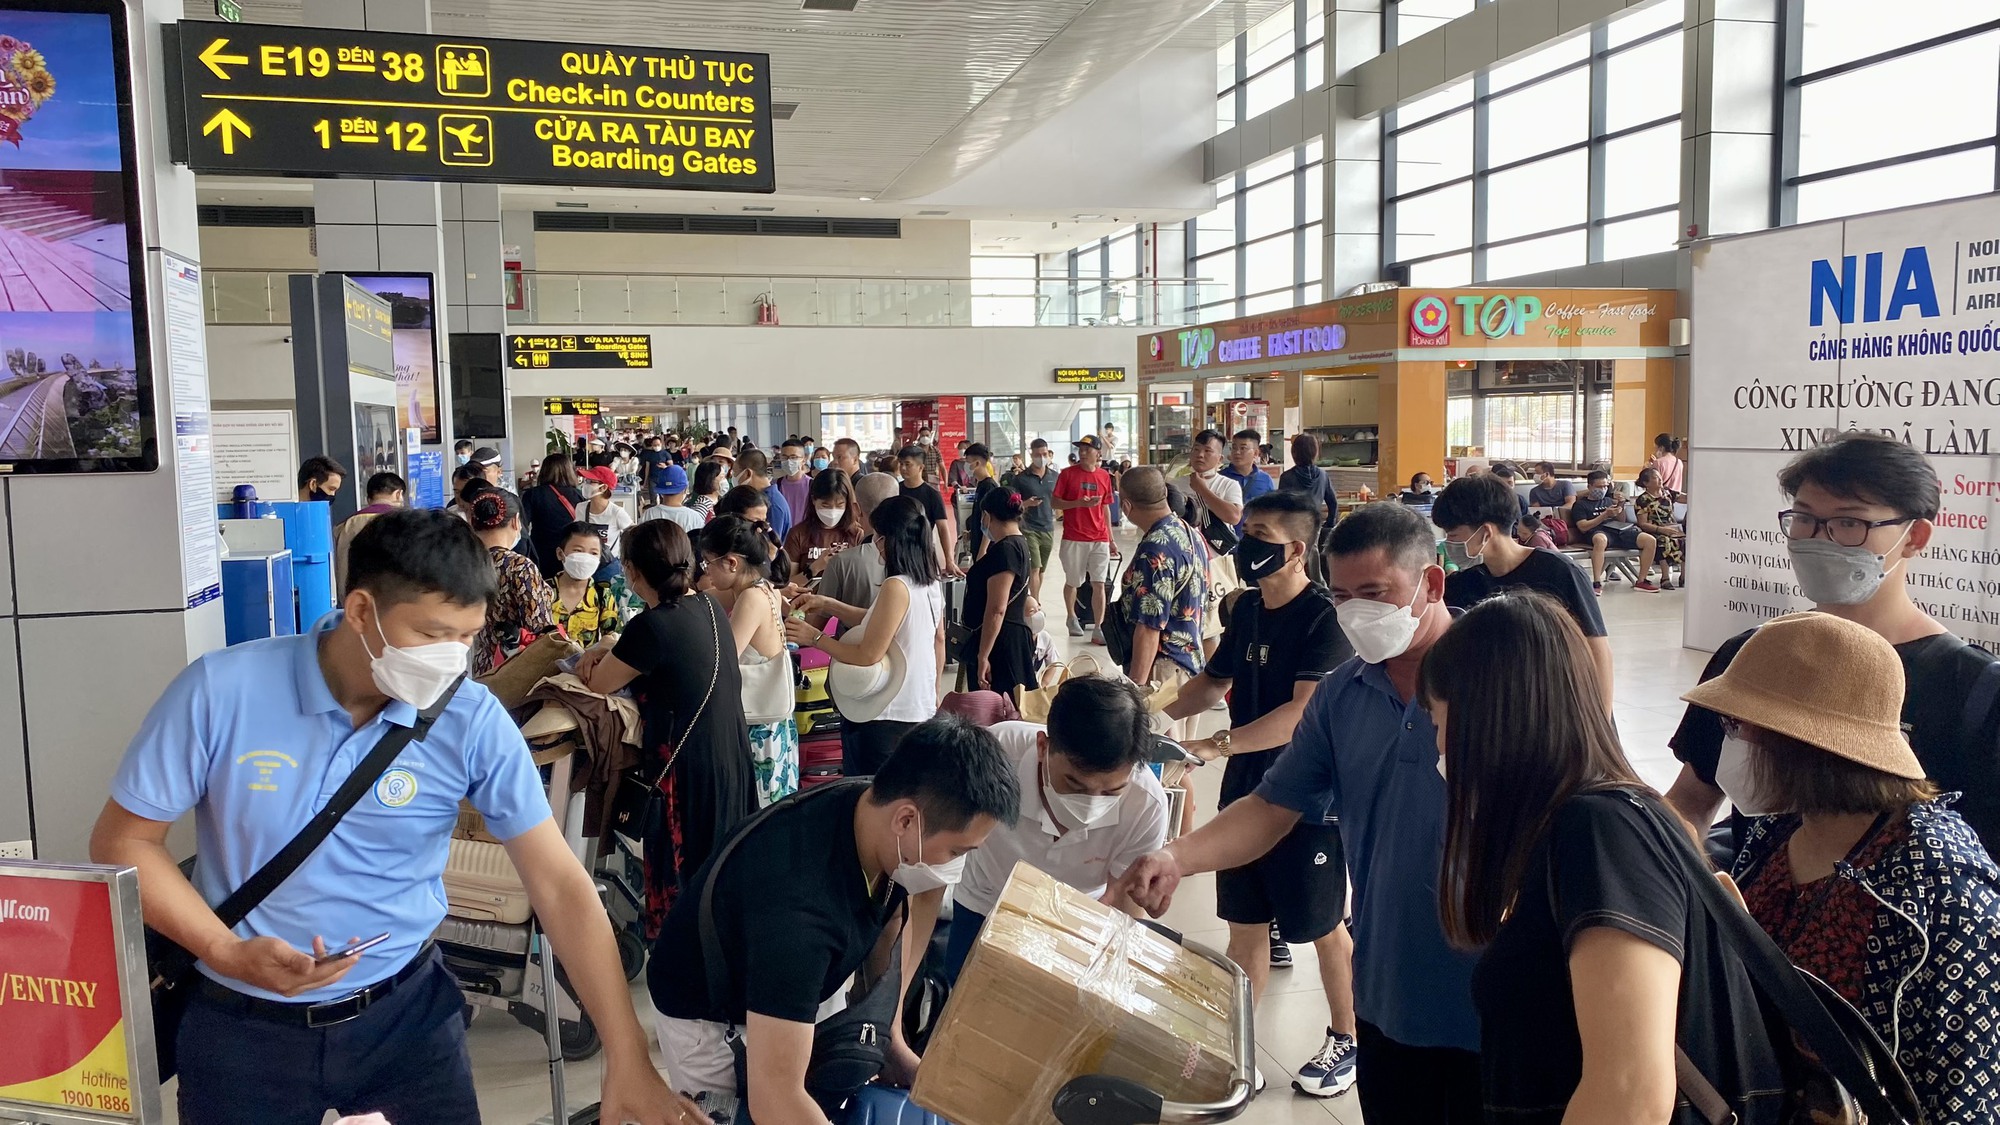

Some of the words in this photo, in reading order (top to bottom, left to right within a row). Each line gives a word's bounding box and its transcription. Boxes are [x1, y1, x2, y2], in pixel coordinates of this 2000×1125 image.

[260, 45, 330, 77] E19
[382, 52, 424, 82] 38
[561, 50, 637, 76] QUẦY
[643, 55, 695, 80] THỦ
[703, 61, 754, 87] TỤC
[507, 78, 627, 107] Check-in
[635, 85, 755, 114] Counters
[313, 119, 330, 149] 1
[385, 121, 427, 151] 12
[534, 115, 595, 142] CỬA
[602, 122, 639, 144] RA
[644, 120, 697, 147] TÀU
[705, 128, 755, 149] BAY
[552, 145, 674, 176] Boarding
[682, 150, 757, 175] Gates
[1810, 246, 1940, 326] NIA
[1454, 294, 1542, 339] TOP
[1544, 302, 1585, 318] Coffee
[1598, 302, 1627, 319] Fast
[1629, 301, 1656, 319] food
[527, 338, 534, 349] 1
[544, 338, 558, 349] 12
[1178, 328, 1215, 369] TOP
[1218, 336, 1262, 363] COFFEE
[1268, 330, 1302, 357] FAST
[1303, 324, 1347, 354] FOOD
[1544, 325, 1569, 339] Top
[1577, 325, 1616, 336] service
[1809, 333, 1847, 361] CẢNG
[1852, 333, 1892, 358] HÀNG
[1898, 329, 1952, 356] KHÔNG
[1734, 379, 1797, 409] CÔNG
[1803, 375, 1913, 408] TRƯỜNG
[1921, 378, 2000, 407] ĐANG
[1925, 420, 1991, 455] LÀM
[1730, 528, 1757, 542] HẠNG
[1752, 554, 1762, 569] VỊ
[1764, 555, 1790, 570] GIÁM
[1932, 544, 1967, 563] HÀNG
[1919, 569, 1954, 589] THÁC
[1956, 578, 1975, 593] GA
[1750, 603, 1760, 618] VỊ
[1962, 606, 1999, 625] HÀNH
[0, 972, 97, 1009] /ENTRY
[82, 1070, 128, 1090] Hotline
[61, 1090, 93, 1108] 1900
[96, 1094, 130, 1112] 1886
